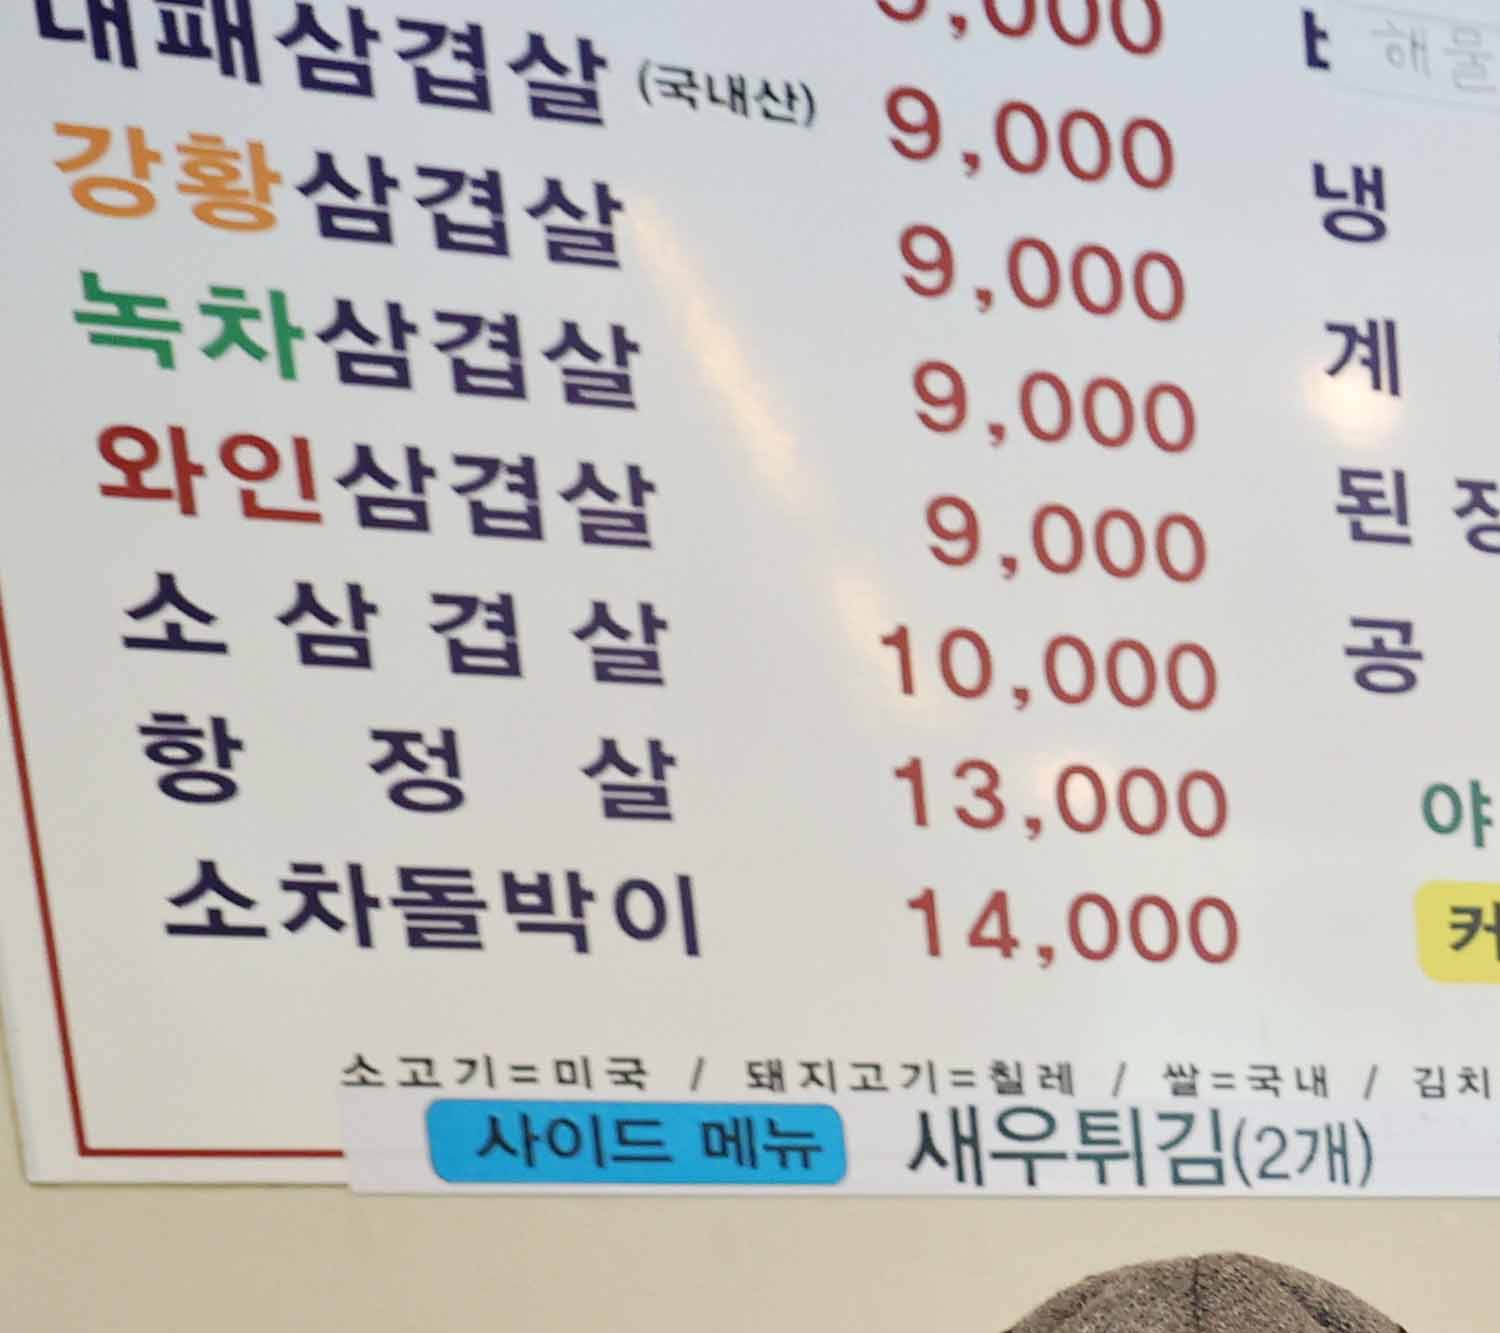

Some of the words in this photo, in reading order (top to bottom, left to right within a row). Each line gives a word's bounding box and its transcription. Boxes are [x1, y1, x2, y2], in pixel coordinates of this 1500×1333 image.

[873, 0, 1165, 56] ,000
[637, 59, 817, 130] (국내산)
[883, 84, 1177, 191] 9,000
[52, 120, 625, 270] 강황삼겹살
[898, 222, 1187, 323] 9,000
[72, 268, 642, 411] 녹차삼겹살
[911, 359, 1198, 456] 9,000
[96, 423, 657, 550] 와인삼겹살
[925, 494, 1209, 584] 9,000
[879, 624, 1219, 712] 10,000
[893, 755, 1229, 840] 13,000
[164, 858, 704, 958] 소차돌박이
[906, 887, 1240, 970] 14,000
[476, 1112, 674, 1169] 사이드
[702, 1116, 825, 1170] 메뉴
[906, 1104, 1374, 1189] 새우튀김(2개)
